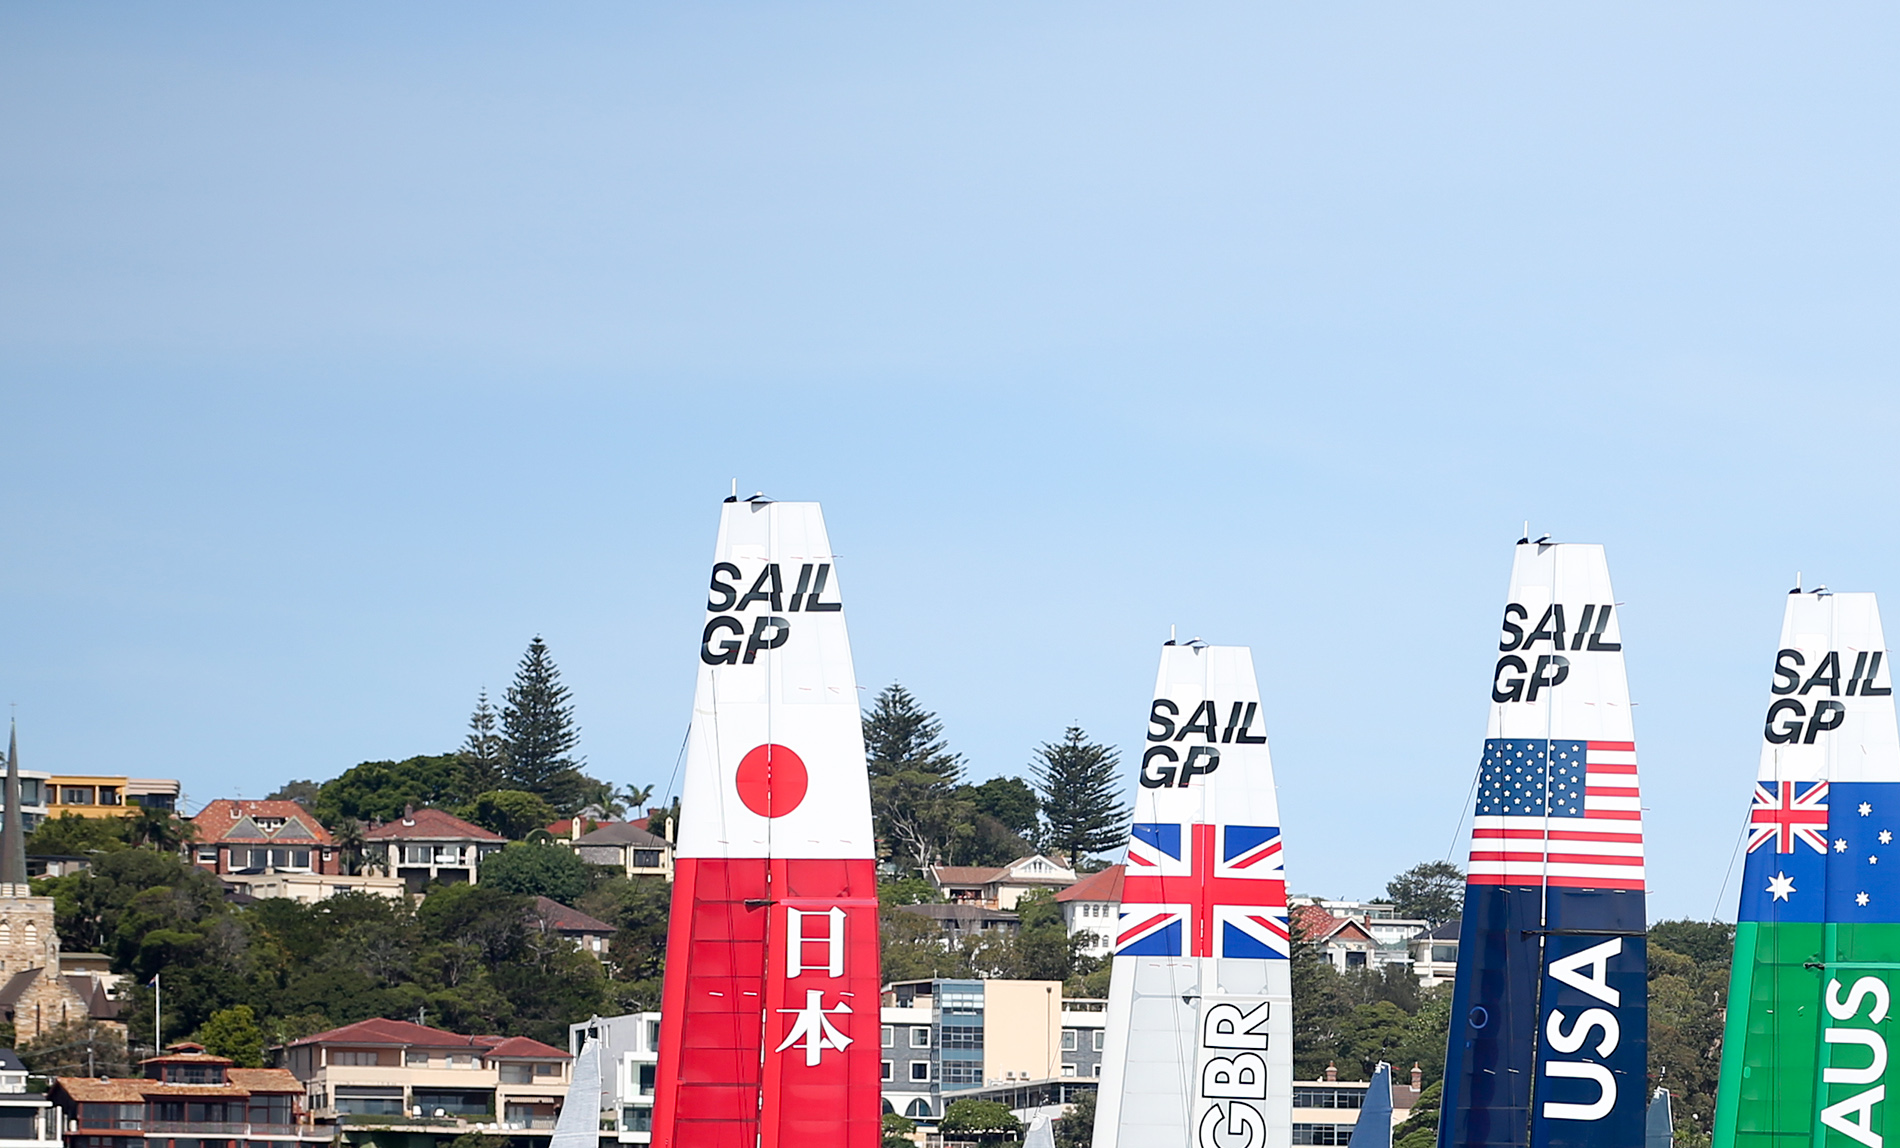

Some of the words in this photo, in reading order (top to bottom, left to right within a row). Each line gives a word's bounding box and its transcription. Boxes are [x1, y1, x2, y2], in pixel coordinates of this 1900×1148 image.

[707, 562, 842, 613] SAIL
[700, 615, 790, 666] GP
[1499, 602, 1622, 652] SAIL
[1491, 654, 1569, 704] GP
[1771, 648, 1892, 697] SAIL
[1146, 698, 1267, 745] SAIL
[1764, 698, 1845, 745] GP
[1139, 745, 1220, 789] GP
[774, 906, 854, 1067] 日本
[1543, 937, 1622, 1121] USA
